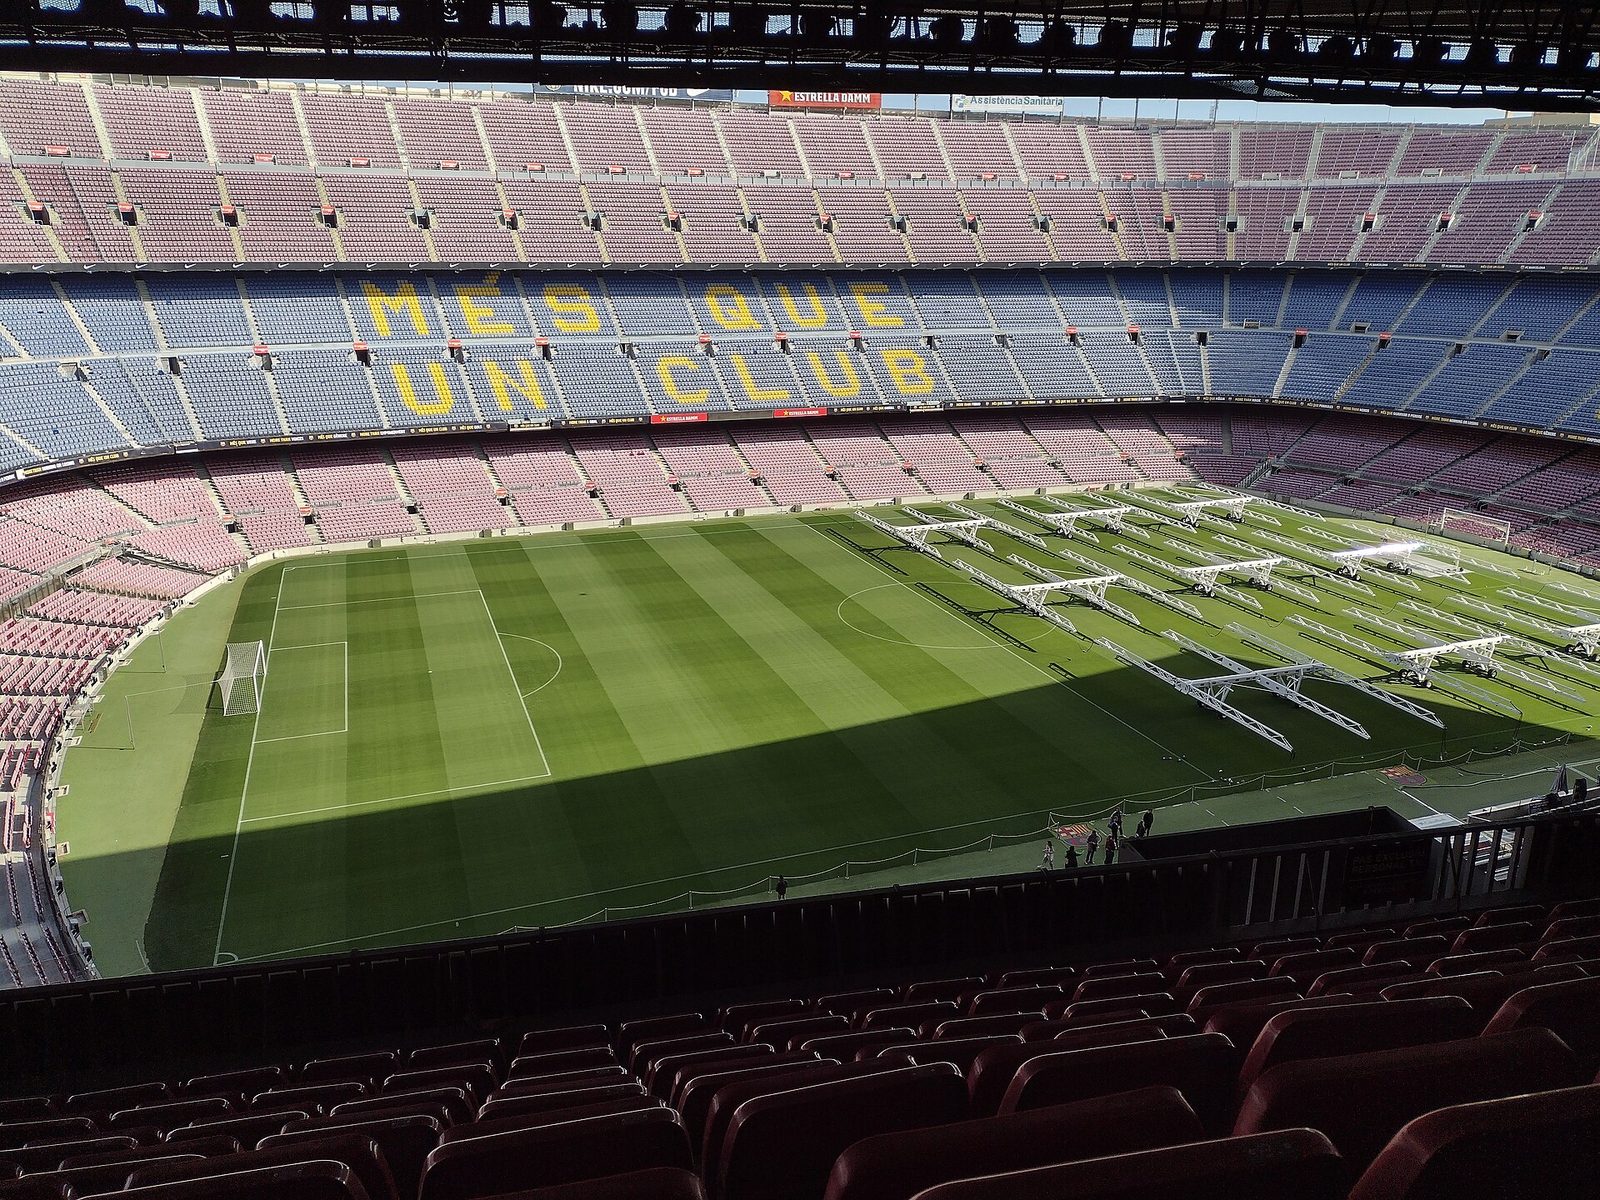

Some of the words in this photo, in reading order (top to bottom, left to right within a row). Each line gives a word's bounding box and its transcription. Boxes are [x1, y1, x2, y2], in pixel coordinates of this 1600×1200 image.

[794, 92, 839, 103] ESTRELLA
[841, 93, 870, 104] DAMM
[358, 272, 602, 339] MÉS
[705, 283, 904, 331] QUE
[392, 359, 547, 417] UN
[654, 349, 935, 405] CLUB
